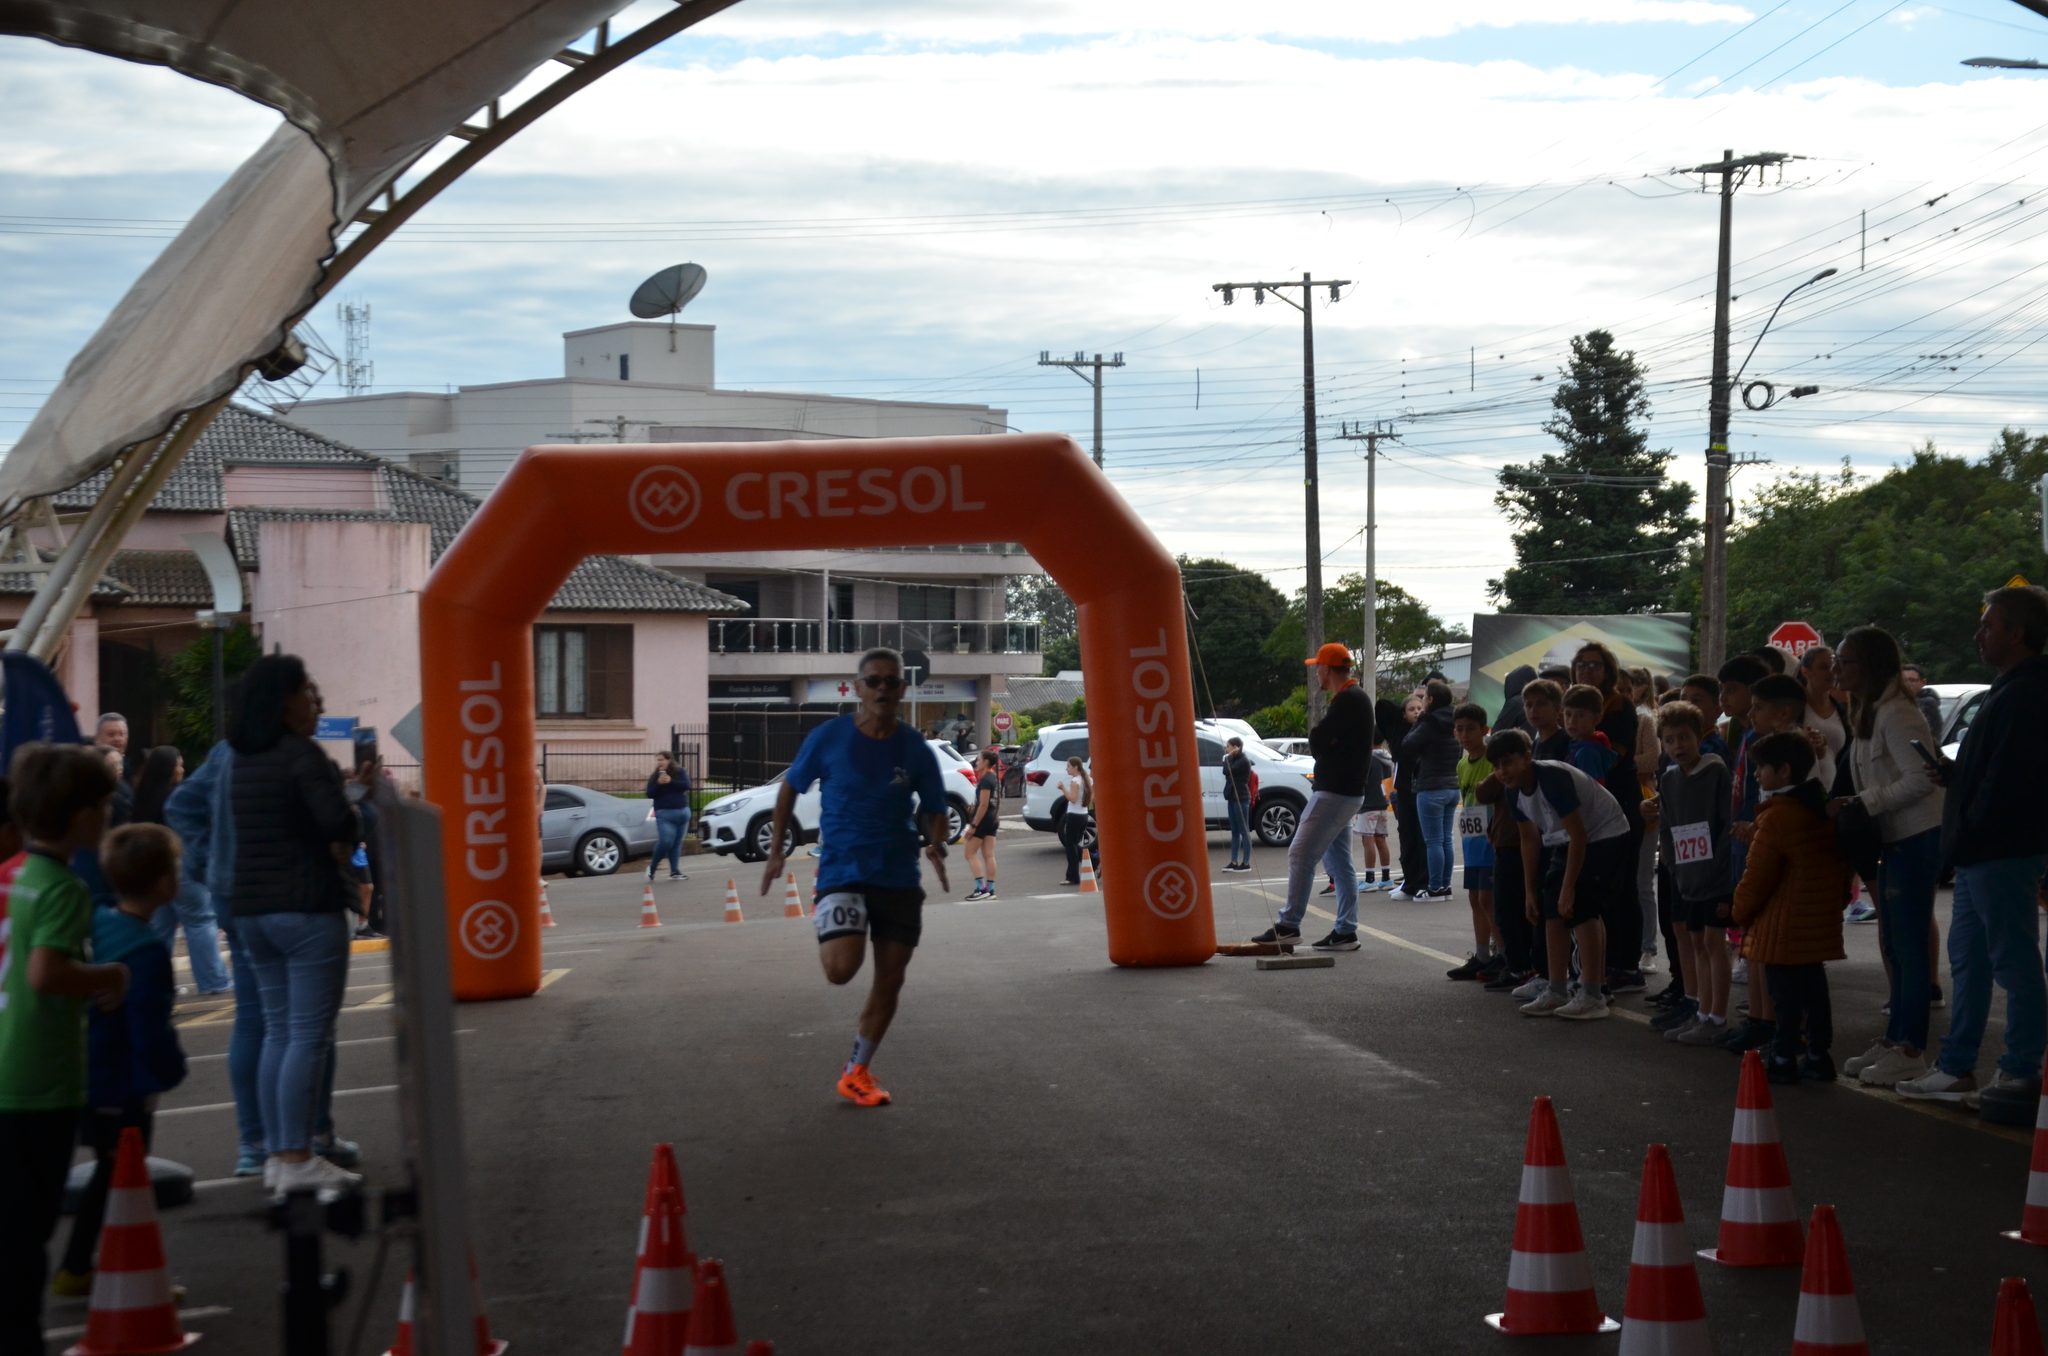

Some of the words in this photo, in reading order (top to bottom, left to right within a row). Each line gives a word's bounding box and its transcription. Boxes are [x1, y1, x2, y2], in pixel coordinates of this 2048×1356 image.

[724, 464, 986, 520] CRESOL
[459, 660, 508, 881] CRESOL
[1130, 627, 1184, 842] CRESOL
[1675, 836, 1709, 861] 1279
